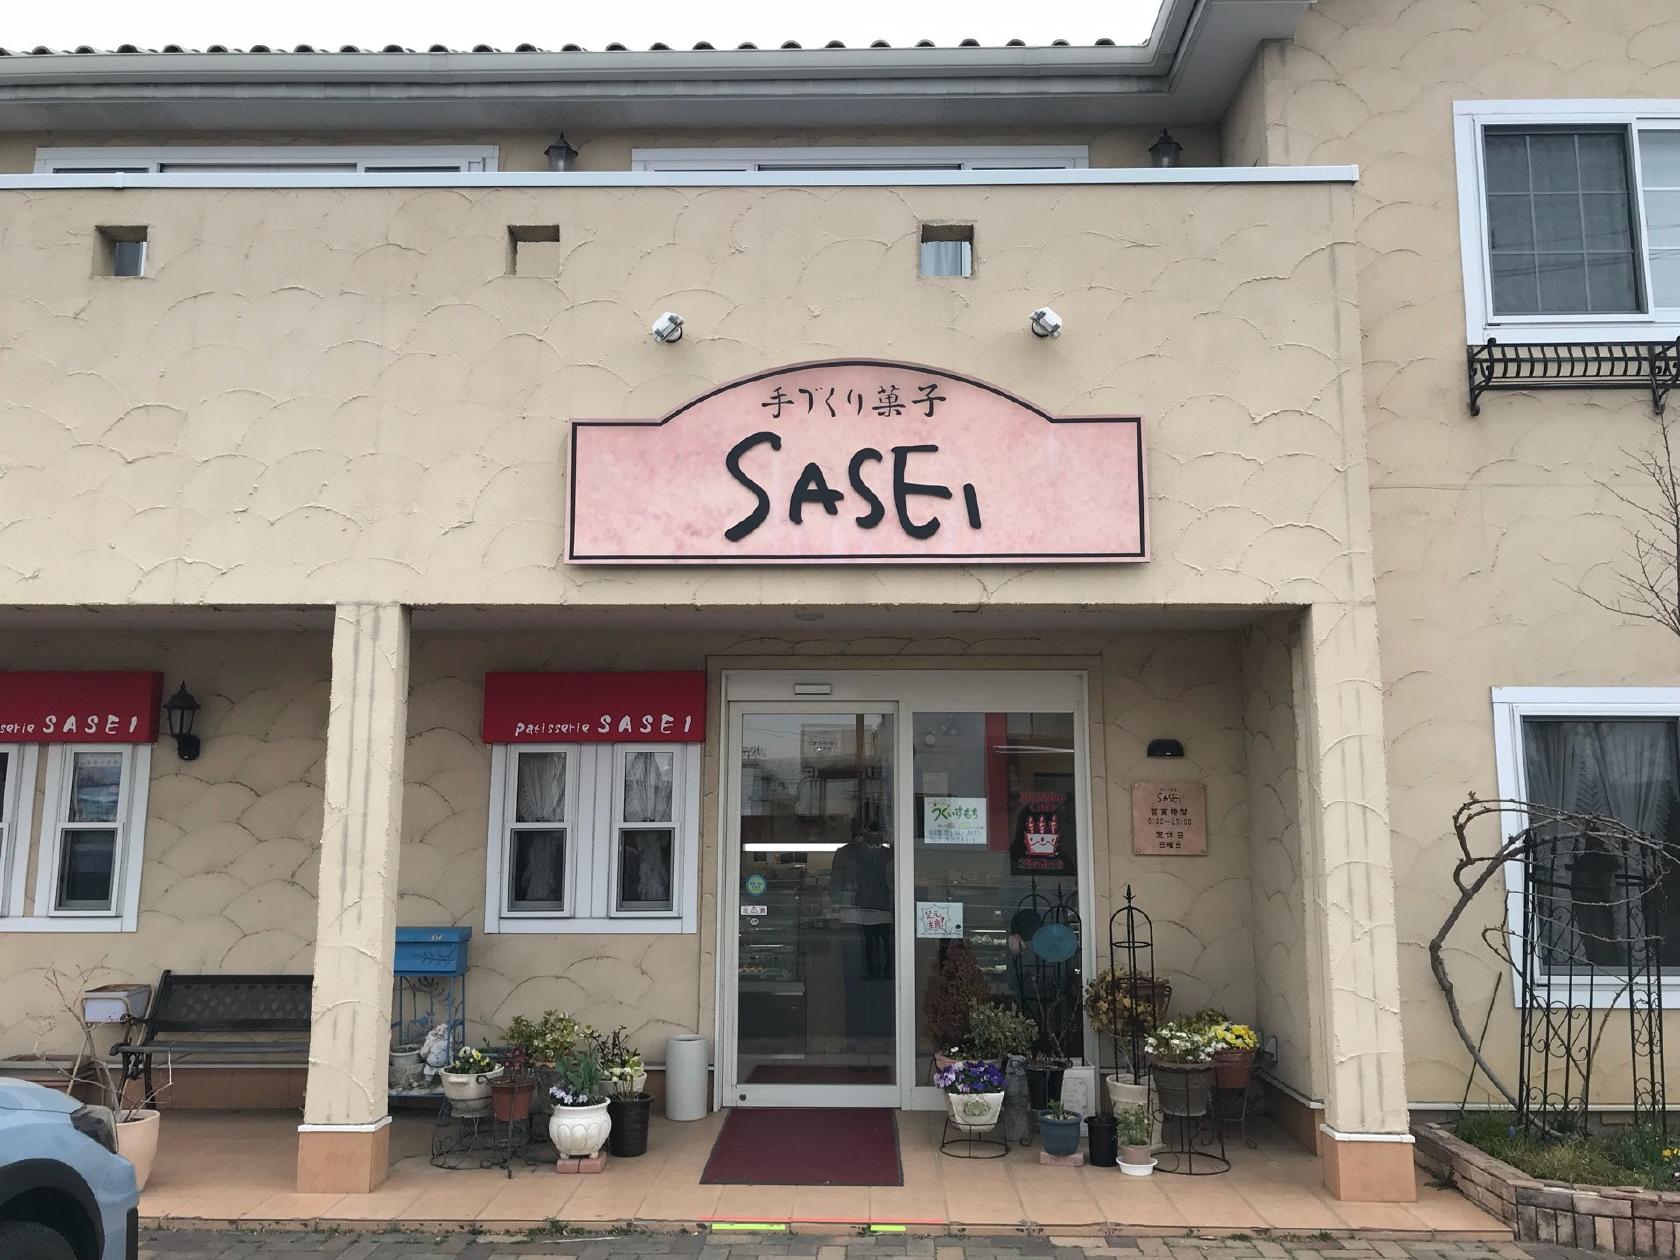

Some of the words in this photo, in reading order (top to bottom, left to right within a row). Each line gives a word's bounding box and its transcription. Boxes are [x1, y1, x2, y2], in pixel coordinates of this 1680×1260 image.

[761, 384, 946, 418] 手づくり菓子
[724, 431, 983, 543] SASEI
[42, 714, 138, 734] SASEI
[514, 721, 590, 737] patisserie
[597, 713, 692, 734] SASEI
